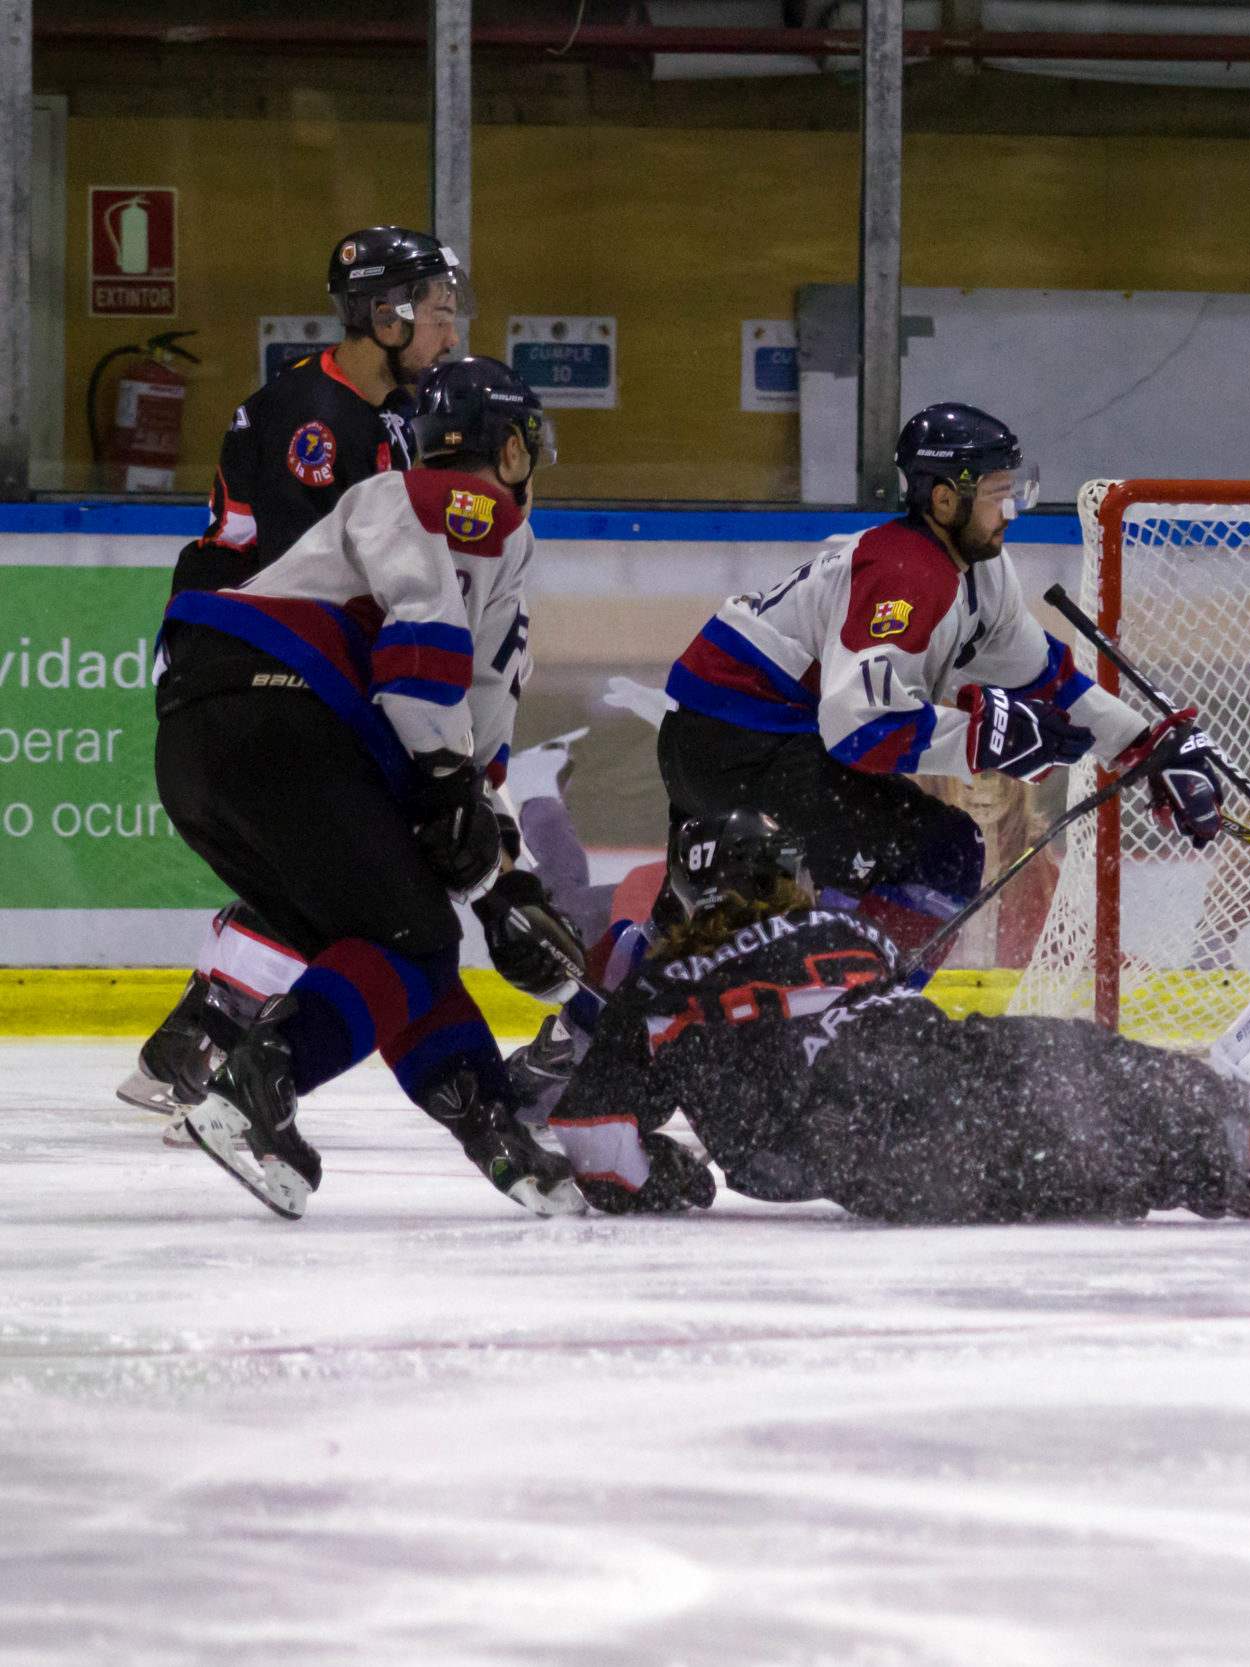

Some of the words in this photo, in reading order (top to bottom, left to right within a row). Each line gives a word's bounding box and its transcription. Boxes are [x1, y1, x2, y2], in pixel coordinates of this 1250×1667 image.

[97, 286, 173, 307] EXTINTOR
[252, 673, 311, 688] BAU
[858, 654, 893, 708] 17
[688, 840, 717, 872] 87
